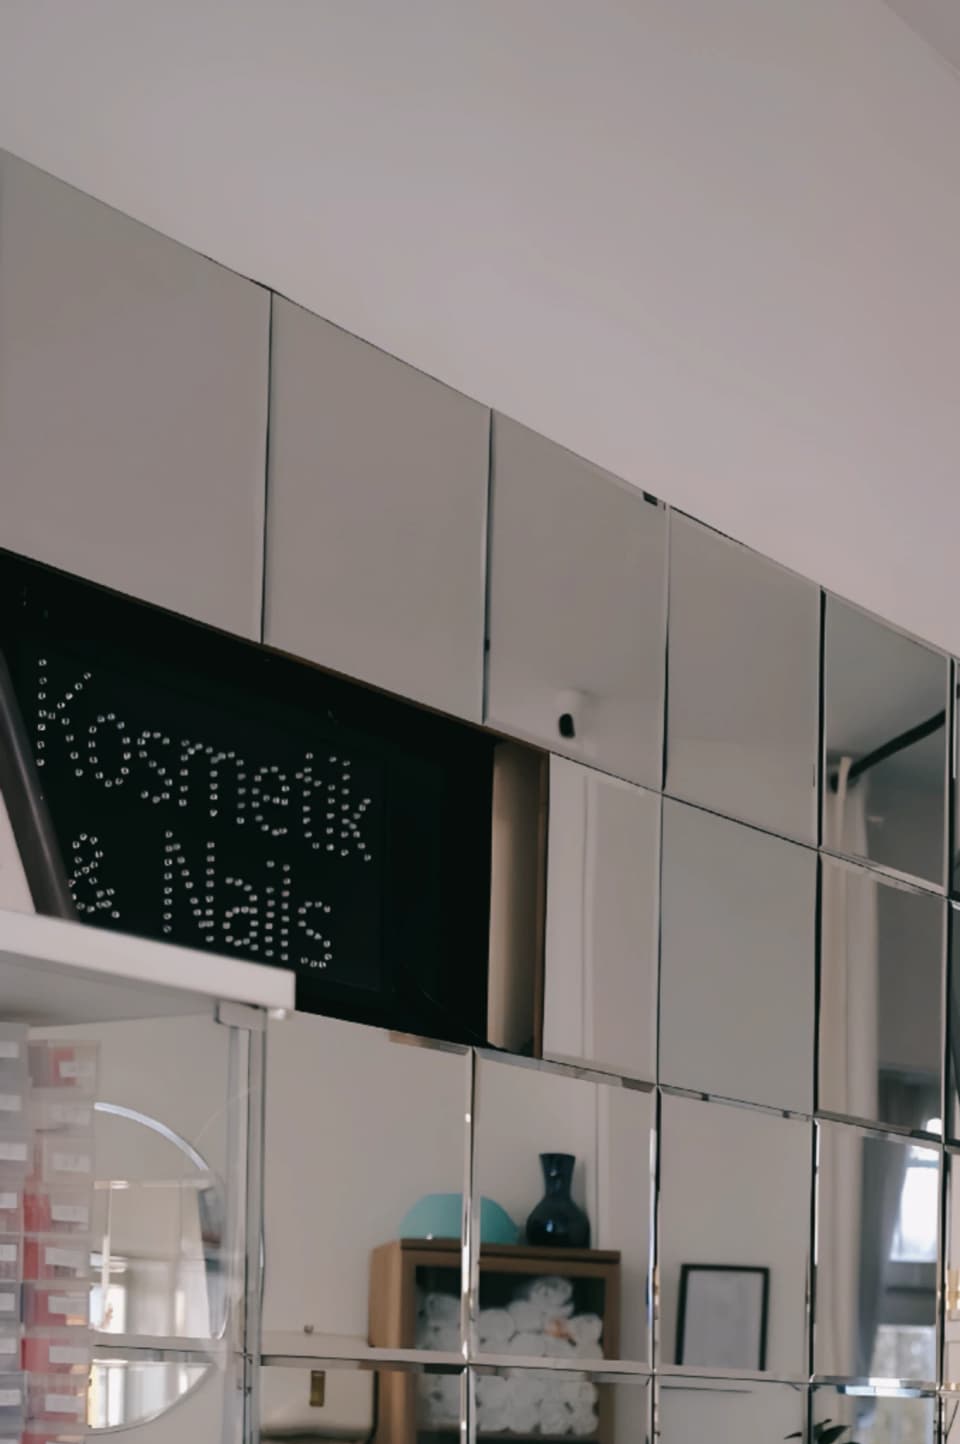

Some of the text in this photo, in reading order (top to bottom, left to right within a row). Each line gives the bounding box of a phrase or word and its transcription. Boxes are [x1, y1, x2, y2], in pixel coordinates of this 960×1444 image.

[36, 658, 372, 862] Kosmetik
[68, 830, 333, 968] & Nails
